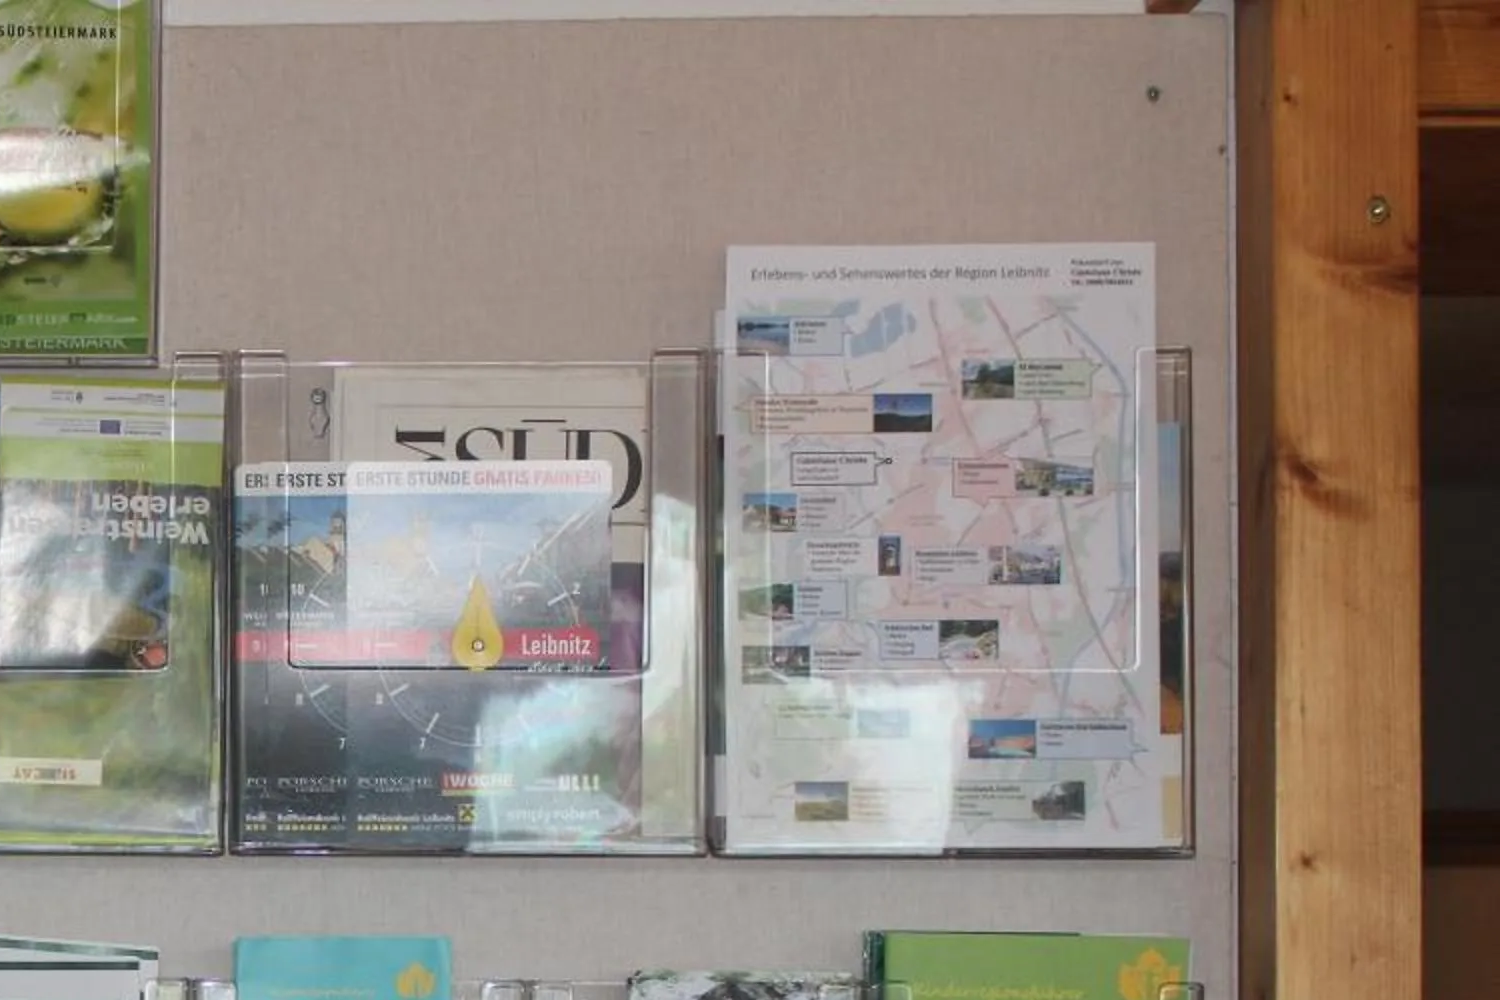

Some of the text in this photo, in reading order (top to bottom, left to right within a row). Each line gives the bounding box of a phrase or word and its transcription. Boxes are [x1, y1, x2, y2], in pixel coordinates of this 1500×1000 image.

[812, 268, 837, 280] und
[929, 267, 951, 280] der
[955, 266, 998, 281] Region
[1001, 266, 1051, 279] Leibnitz
[276, 473, 323, 489] ERSTE
[355, 471, 403, 487] ERSTE
[406, 470, 470, 486] STUNDE
[473, 469, 530, 486] GRATIS
[91, 494, 211, 519] erleben
[521, 633, 592, 656] Leibnitz
